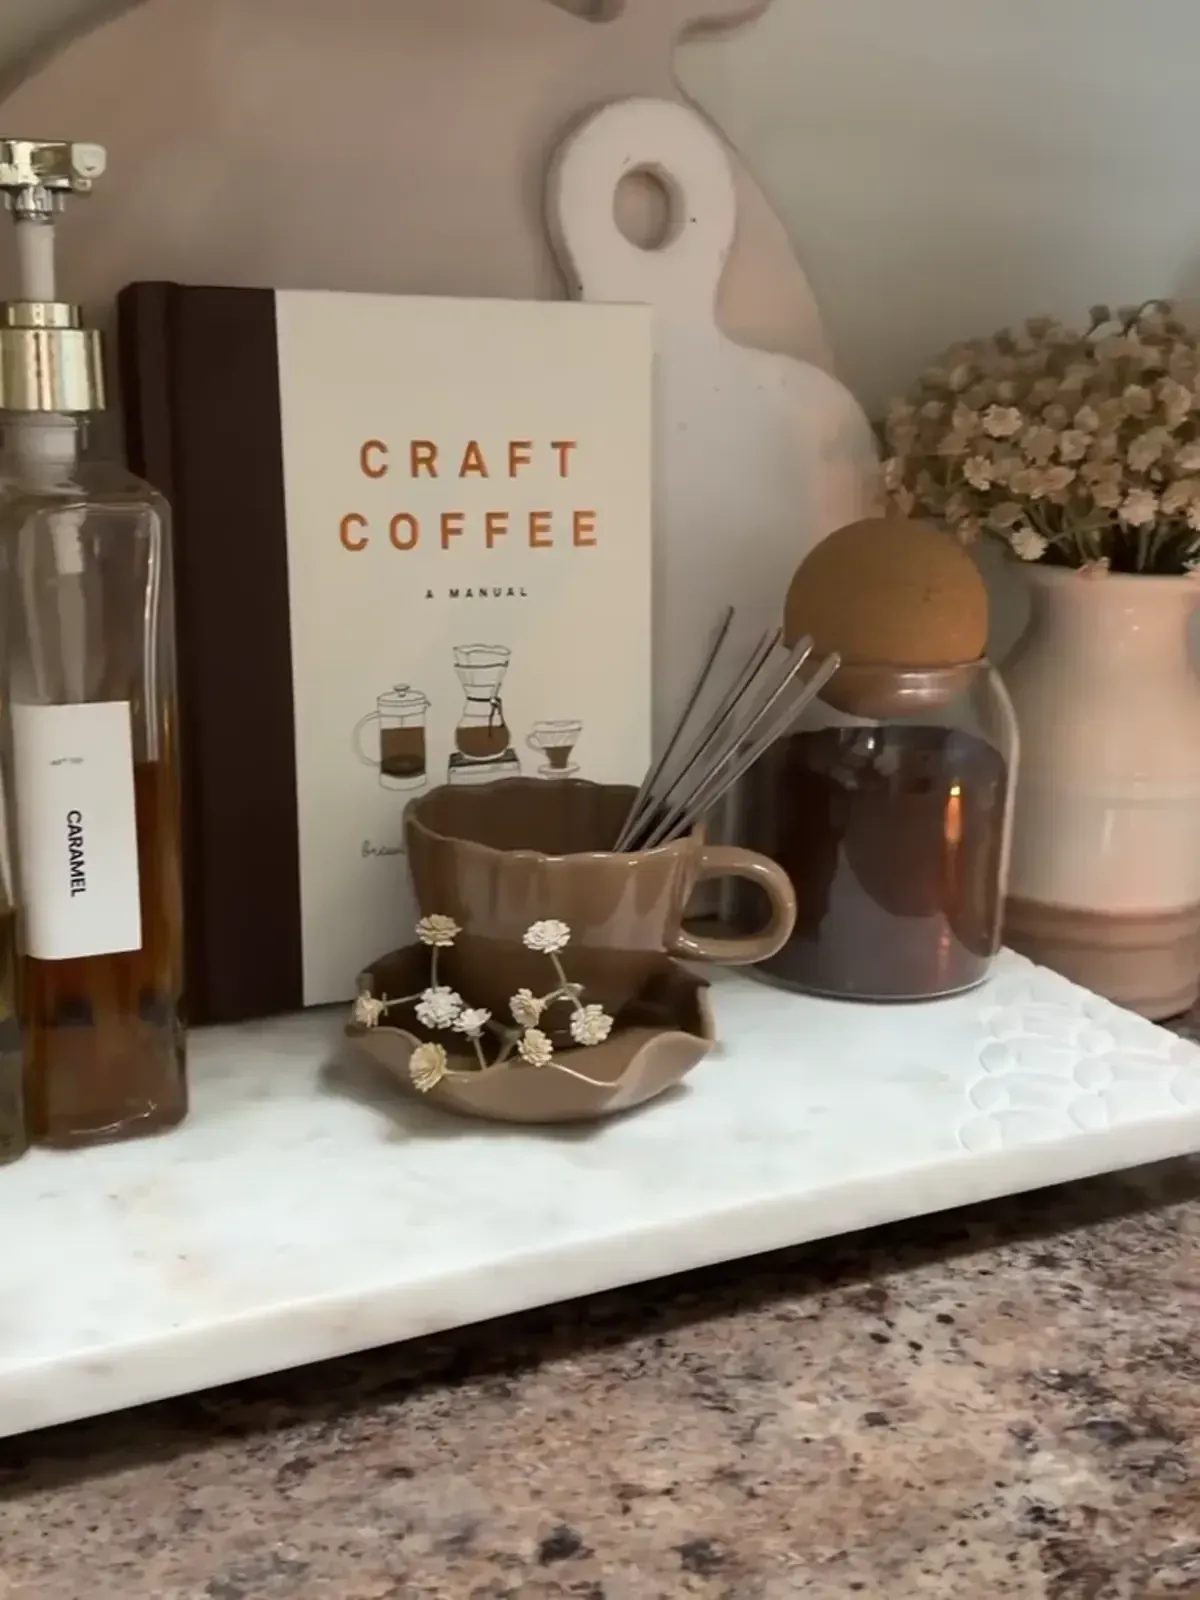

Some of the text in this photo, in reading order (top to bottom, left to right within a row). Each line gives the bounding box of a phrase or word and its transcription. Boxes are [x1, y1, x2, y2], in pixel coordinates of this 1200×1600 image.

[360, 439, 577, 478] CRAFT
[339, 510, 597, 551] COFFEE
[425, 587, 527, 599] A MANUAL
[66, 810, 86, 896] CARAMEL
